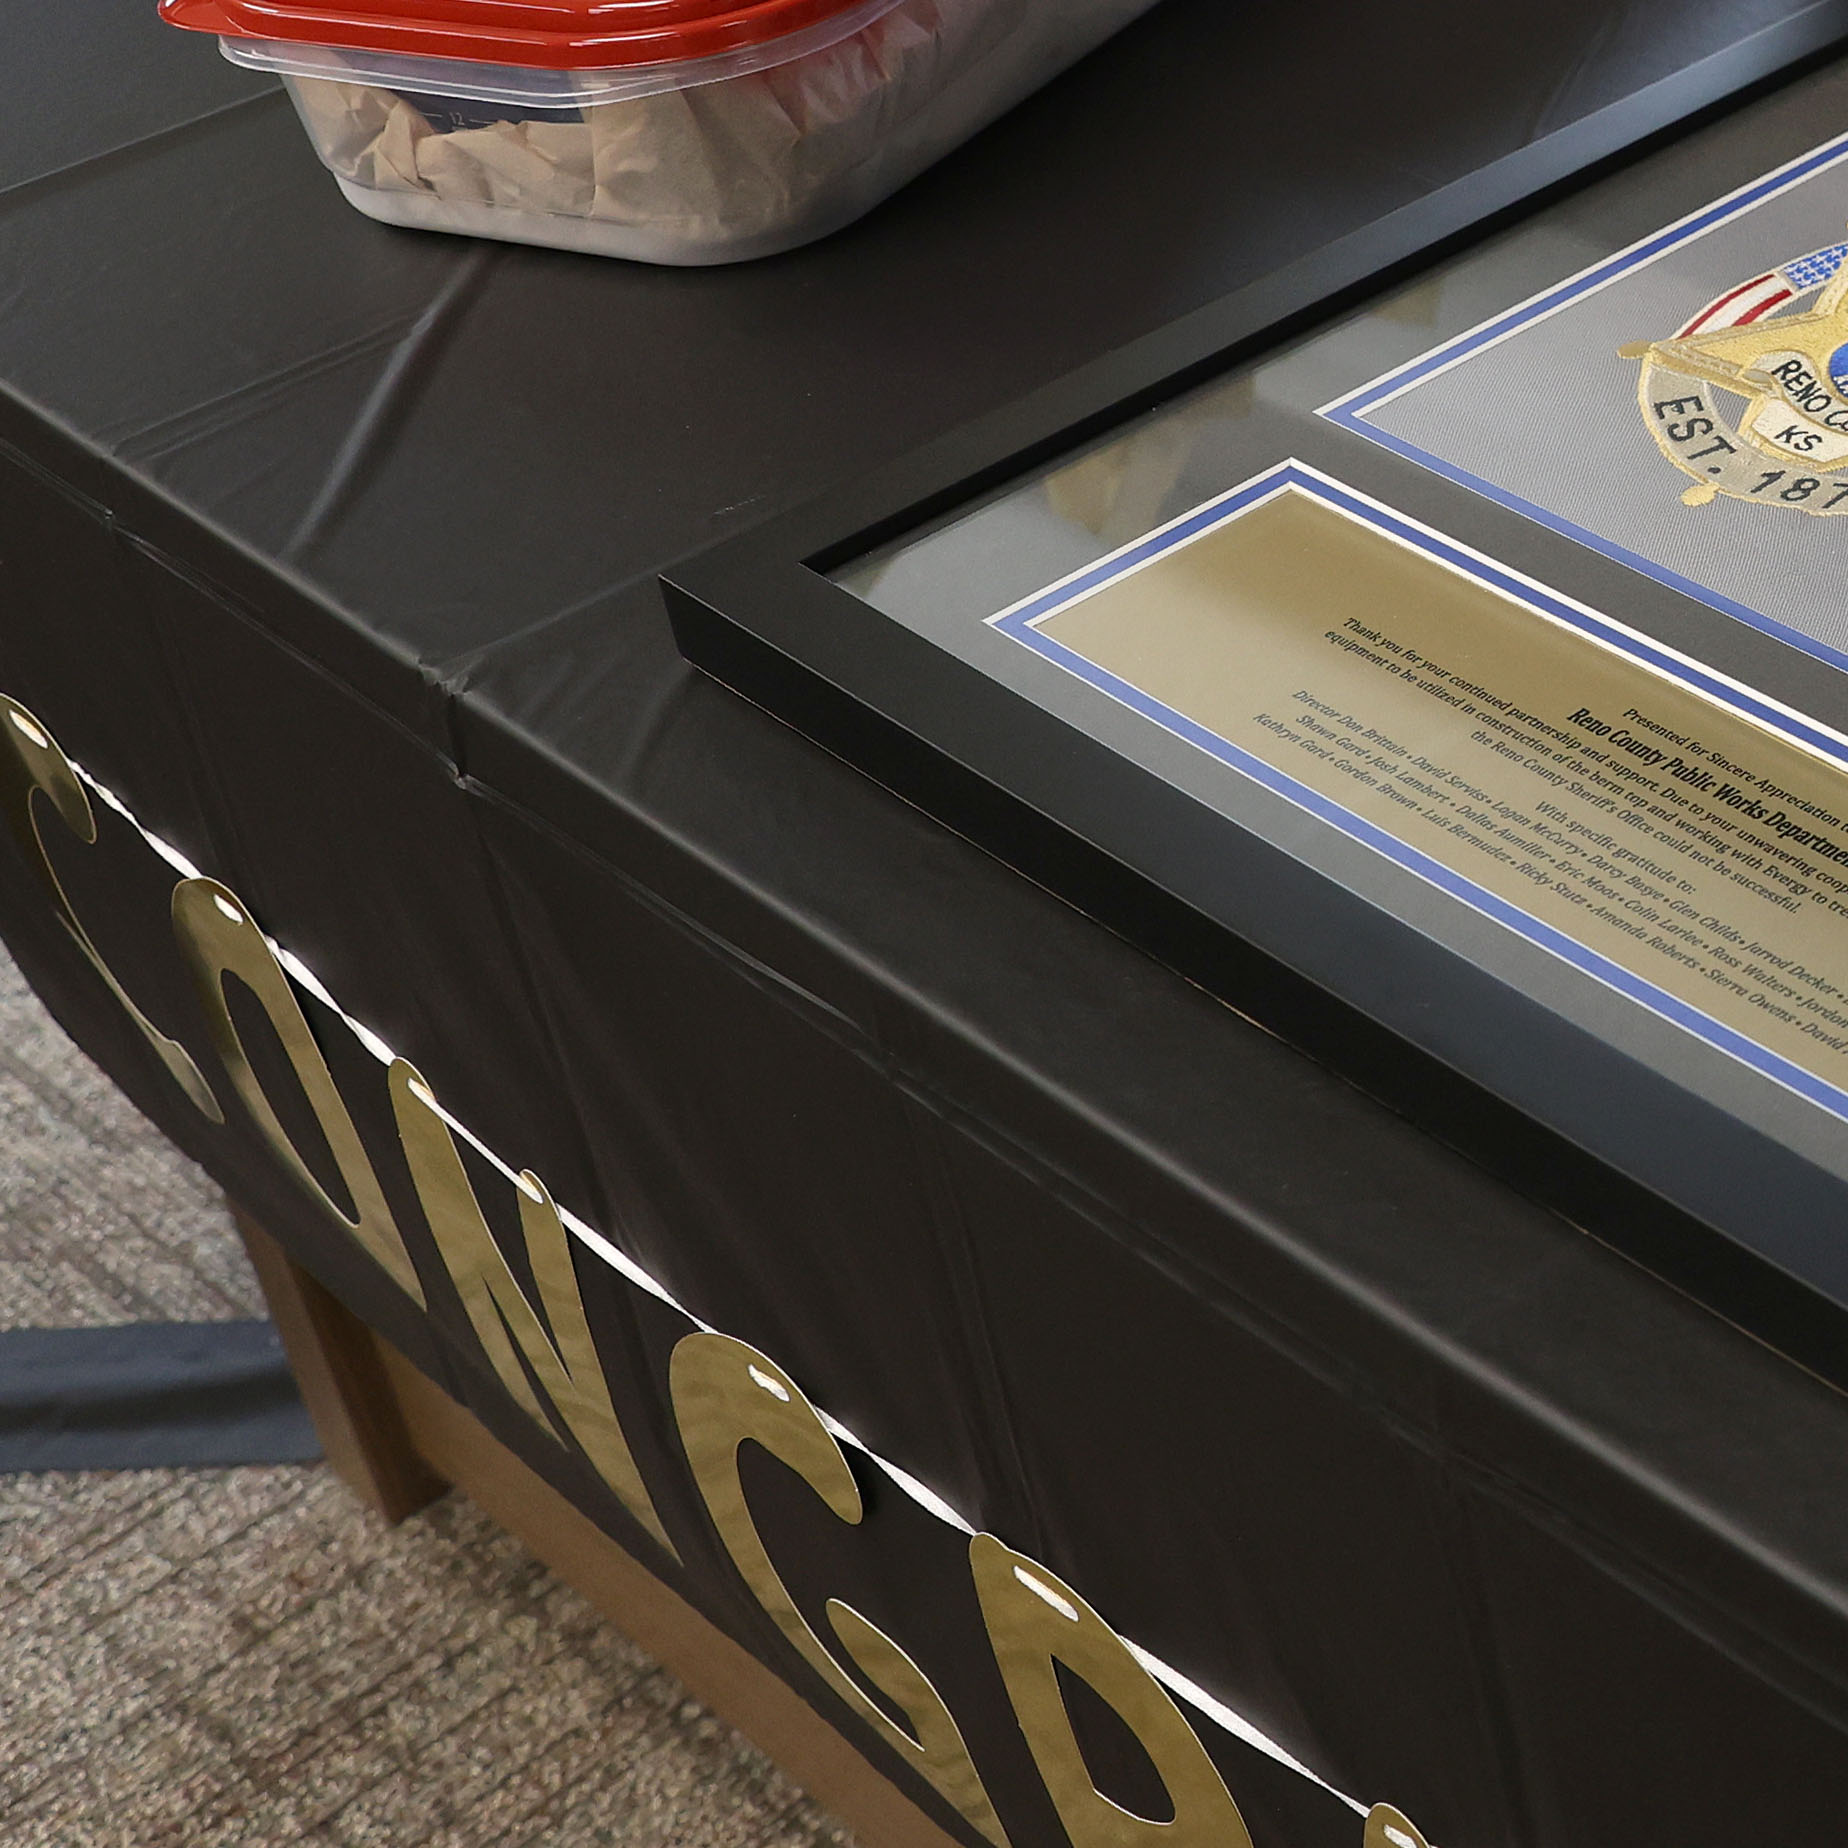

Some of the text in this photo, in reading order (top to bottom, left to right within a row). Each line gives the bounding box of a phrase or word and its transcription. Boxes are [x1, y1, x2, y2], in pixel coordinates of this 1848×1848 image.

[1653, 394, 1737, 475] EST.
[1771, 359, 1832, 413] RENO
[1774, 424, 1824, 453] KS
[1323, 630, 1389, 667] equipment
[1384, 662, 1402, 674] to
[1398, 668, 1418, 683] be
[1415, 679, 1466, 707] utilized
[1459, 702, 1477, 715] in
[1474, 711, 1553, 756] construction
[1551, 753, 1573, 764] of
[1565, 759, 1590, 776] the
[1587, 770, 1625, 795] berm
[1623, 791, 1649, 808] top
[1645, 804, 1679, 822] and
[1673, 818, 1732, 854] working
[1729, 848, 1763, 870] with
[1761, 863, 1814, 896] Evergy
[1810, 890, 1828, 904] to
[1342, 616, 1382, 642] Thank
[1373, 637, 1403, 654] you
[1399, 649, 1423, 663] for
[1414, 660, 1452, 678] your
[1448, 676, 1513, 711] continued
[1503, 707, 1582, 749] partnership
[1578, 746, 1611, 763] and
[1604, 759, 1660, 792] support.
[1658, 786, 1689, 807] Due
[1687, 802, 1705, 815] to
[1697, 811, 1739, 832] your
[1735, 829, 1818, 877] unwavering
[1469, 729, 1493, 745] the
[1489, 740, 1524, 762] Reno
[1521, 758, 1569, 786] County
[1615, 809, 1654, 834] Office
[1651, 830, 1694, 853] could
[1687, 849, 1715, 867] not
[1711, 860, 1732, 876] be
[1728, 872, 1802, 914] successful.
[1565, 707, 1612, 736] Reno
[1607, 729, 1668, 766] County
[1658, 756, 1717, 792] Public
[1711, 782, 1770, 819] Works
[1621, 707, 1691, 746] Presented
[1683, 741, 1710, 756] for
[1705, 752, 1756, 782] Sincere
[1752, 778, 1841, 827] Appreciation
[1252, 712, 1302, 742] Kathryn
[1298, 739, 1335, 759] Gard
[1333, 758, 1378, 786] Gordon
[1375, 782, 1418, 809] Brown
[1420, 808, 1451, 827] Luis
[1445, 823, 1512, 862] Bermudez
[1514, 861, 1554, 885] Ricky
[1588, 906, 1648, 940] Amanda
[1644, 935, 1701, 969] Roberts
[1703, 968, 1749, 997] Sierra
[1747, 992, 1797, 1023] Owens
[1291, 689, 1342, 718] Director
[1360, 728, 1408, 757] Brittain
[1409, 756, 1452, 779] David
[1443, 775, 1489, 801] Serviss
[1489, 800, 1531, 826] Logan
[1527, 821, 1584, 854] McCurry
[1585, 854, 1627, 878] Darcy
[1668, 899, 1700, 920] Glen
[1698, 916, 1741, 942] Childs
[1738, 941, 1794, 969] Jarrod
[1786, 965, 1839, 994] Decker
[1294, 714, 1337, 740] Shawn
[1334, 737, 1371, 757] Gard
[1364, 756, 1399, 774] Josh
[1393, 770, 1450, 803] Lambert
[1454, 804, 1498, 830] Dallas
[1492, 827, 1552, 859] Aumiller
[1553, 859, 1585, 879] Eric
[1579, 875, 1620, 899] Moos
[1623, 899, 1660, 922] Colin
[1706, 945, 1742, 968] Ross
[1740, 963, 1797, 998] Walters
[1534, 800, 1696, 895] With specific gratitude to:
